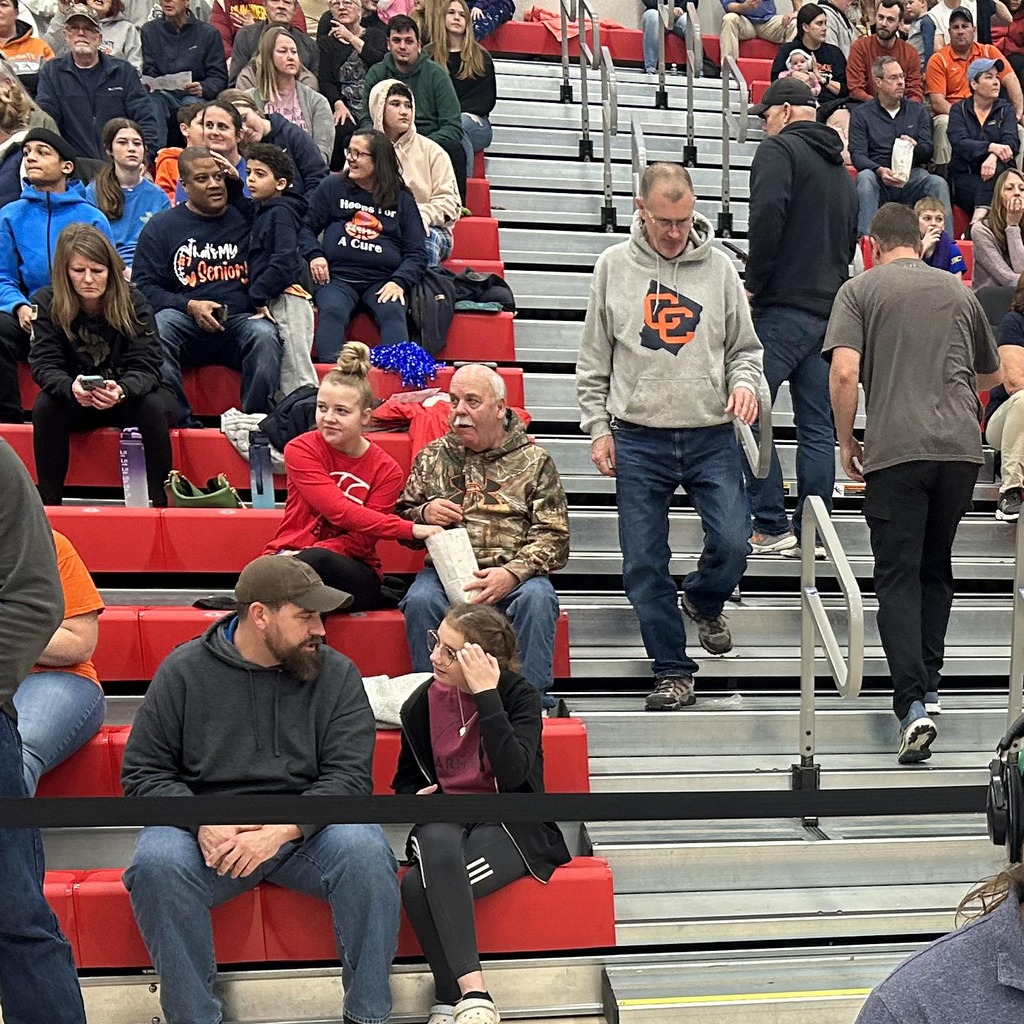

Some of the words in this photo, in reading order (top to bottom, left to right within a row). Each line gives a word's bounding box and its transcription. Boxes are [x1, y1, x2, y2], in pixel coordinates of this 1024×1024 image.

[338, 236, 347, 247] A
[350, 238, 383, 253] Cure
[643, 292, 696, 344] CC
